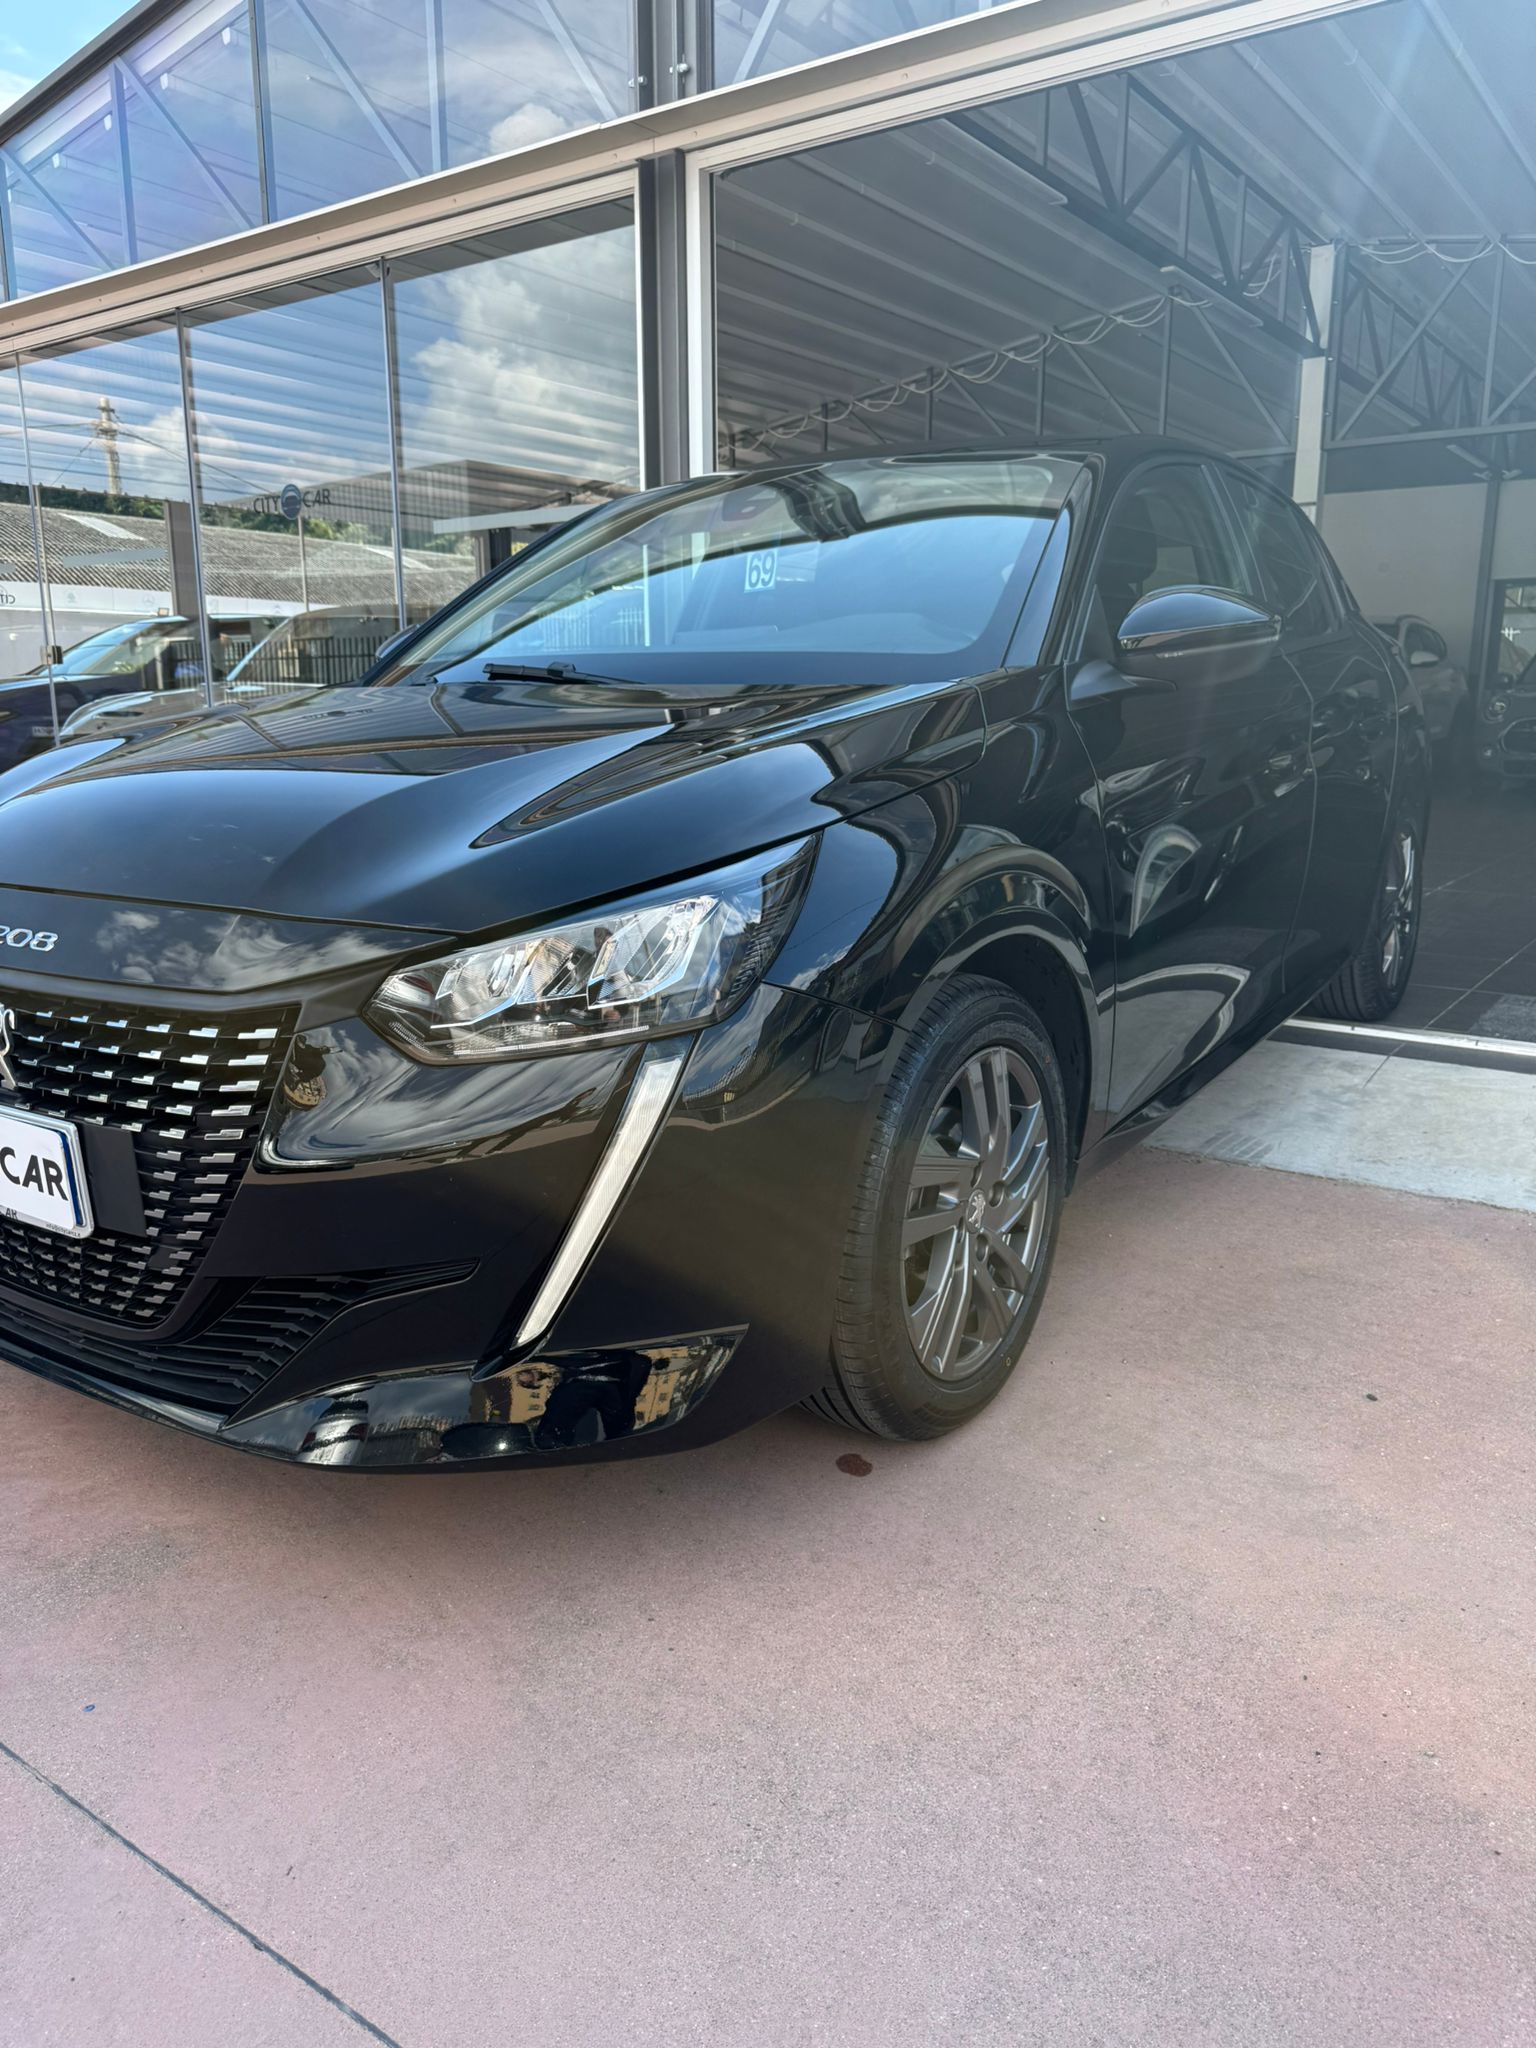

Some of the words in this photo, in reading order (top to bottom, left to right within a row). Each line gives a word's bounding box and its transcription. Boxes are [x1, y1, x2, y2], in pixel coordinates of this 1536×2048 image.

[253, 495, 280, 514] CITY
[303, 489, 331, 508] CAR
[750, 551, 775, 588] 69
[0, 1146, 69, 1201] CAR
